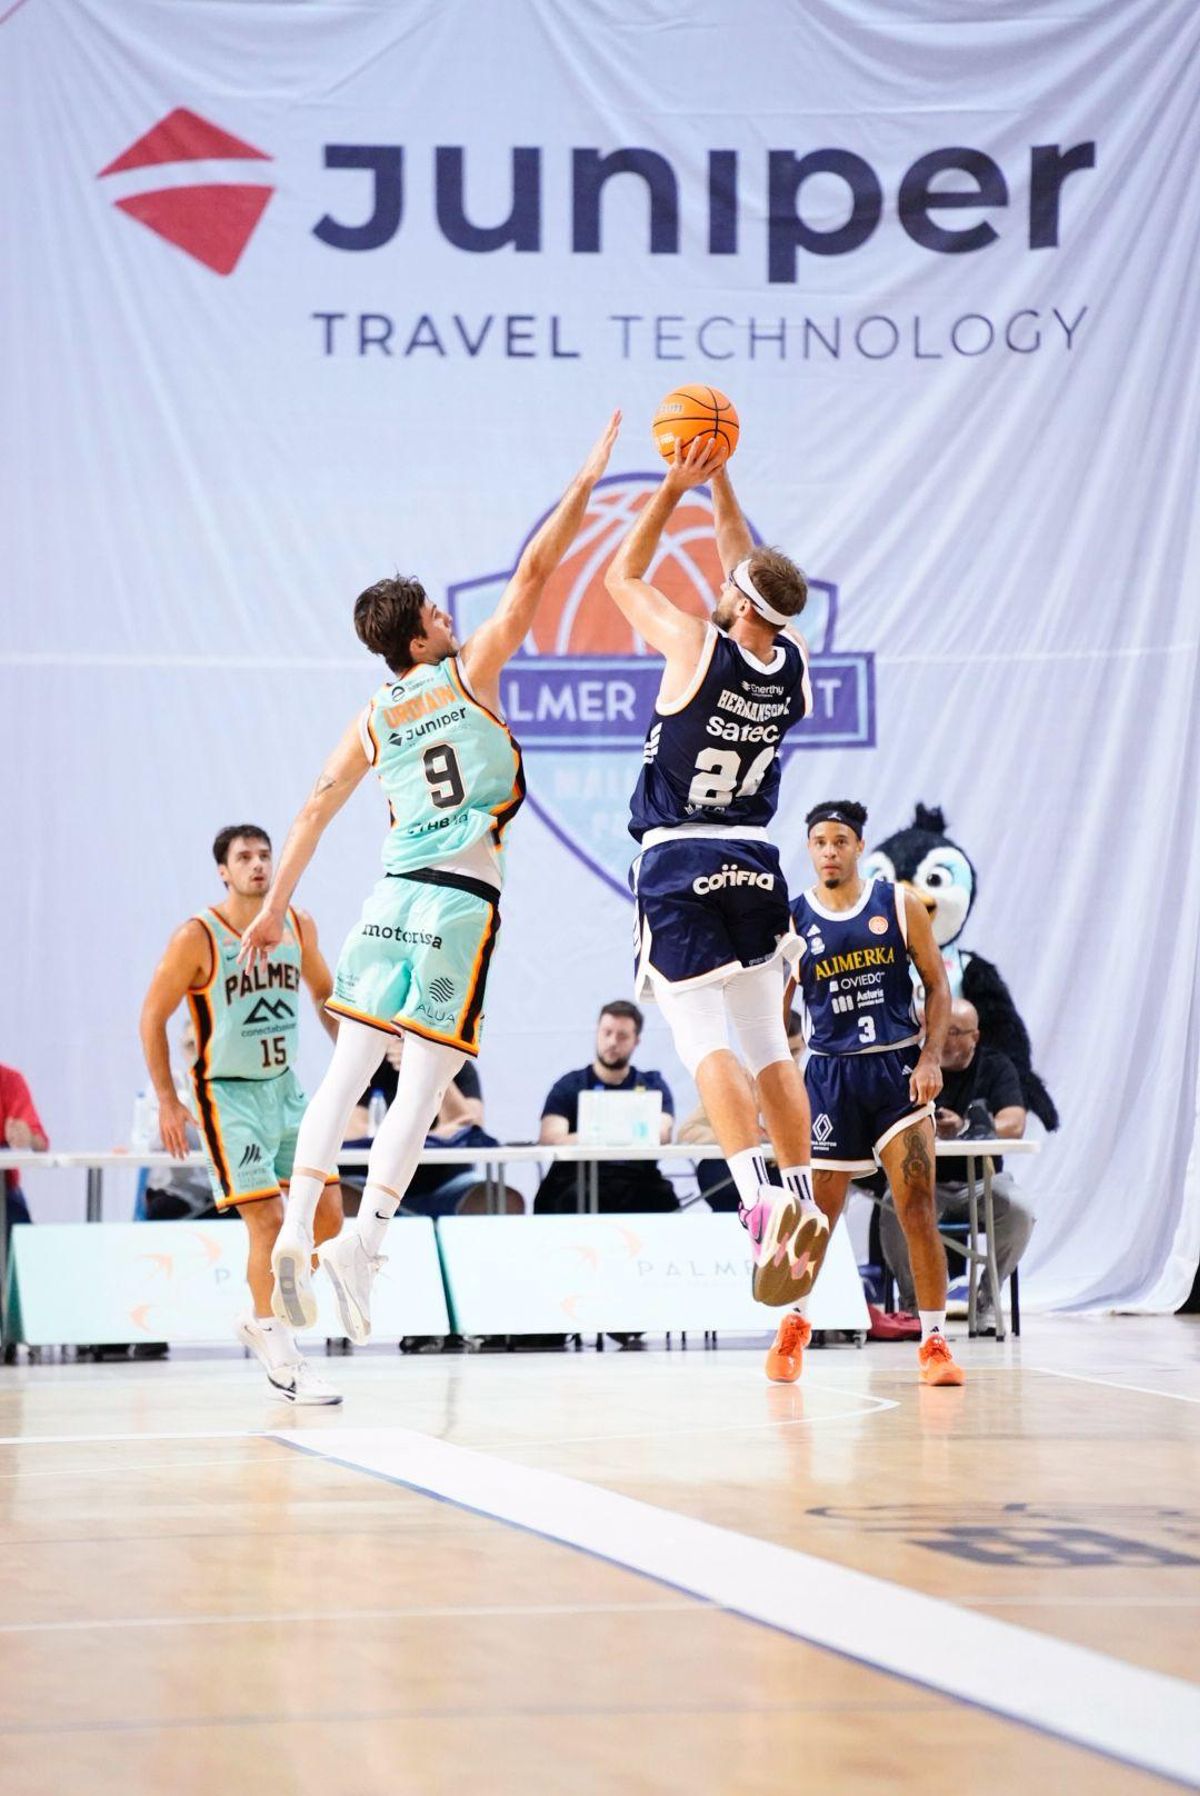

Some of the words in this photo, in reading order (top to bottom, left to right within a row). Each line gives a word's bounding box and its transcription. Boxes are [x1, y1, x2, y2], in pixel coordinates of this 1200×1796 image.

[311, 141, 1096, 282] Juniper
[312, 312, 581, 359] TRAVEL
[609, 306, 1089, 361] TECHNOLOGY
[503, 680, 637, 722] LMER
[706, 716, 779, 744] satec
[422, 743, 466, 809] 9
[362, 922, 443, 950] motorisa
[816, 946, 894, 981] ALIMERKA
[416, 1003, 456, 1024] ALUA
[858, 1015, 876, 1044] 3
[261, 1036, 287, 1068] 15
